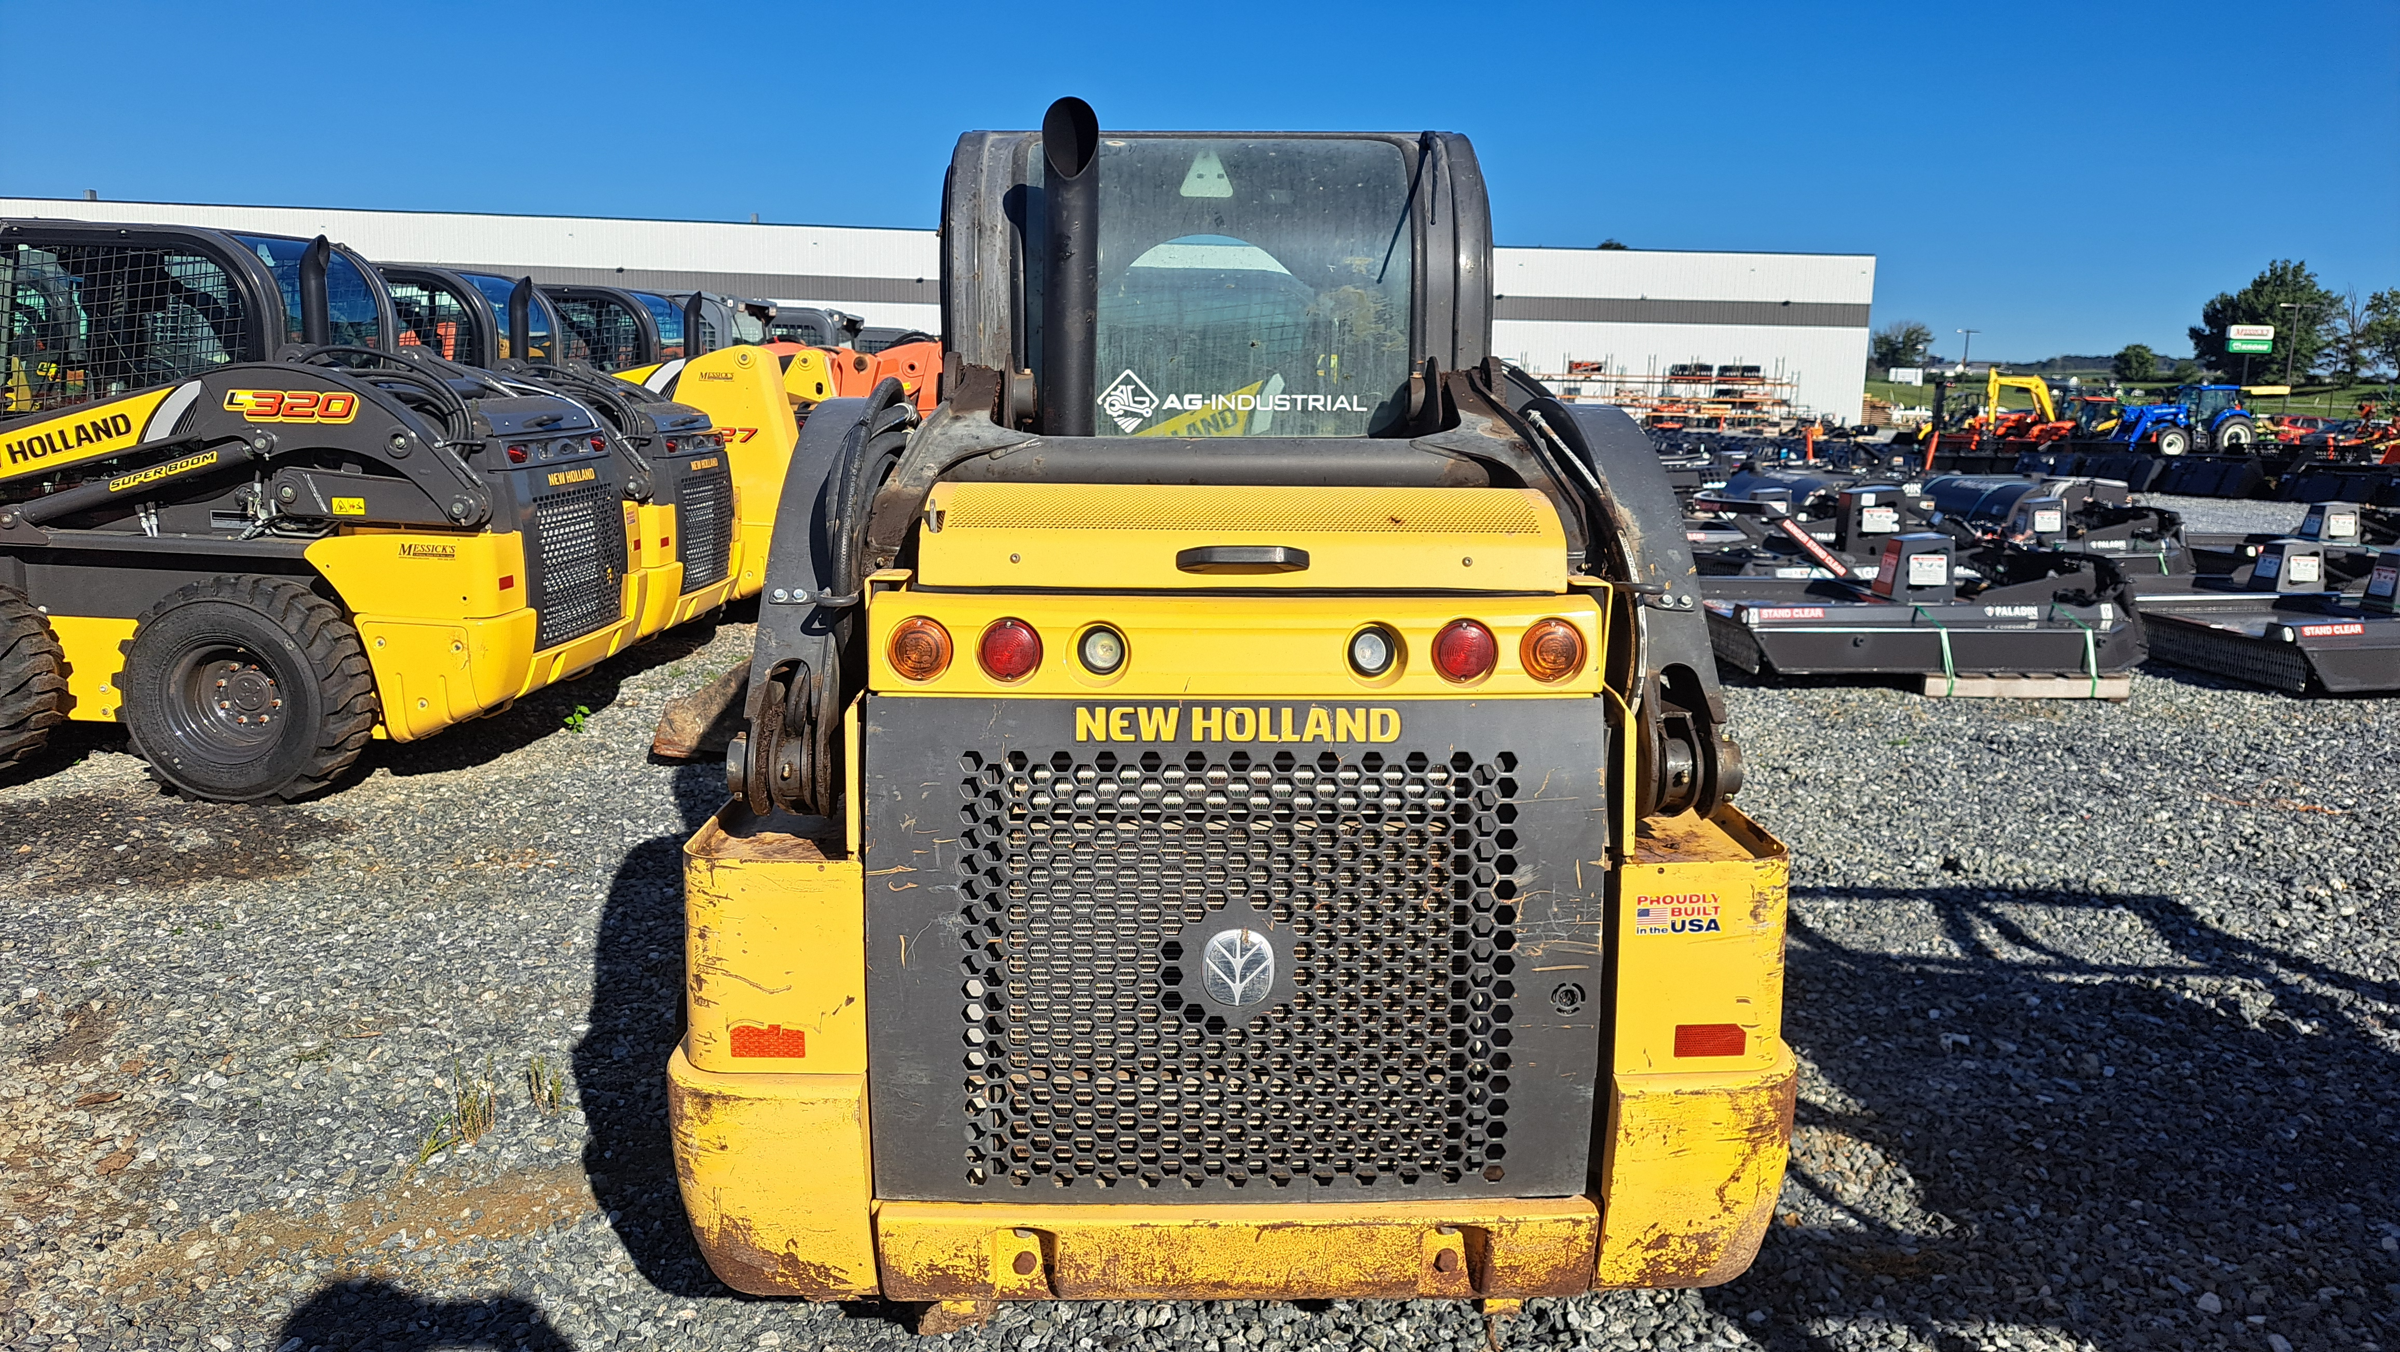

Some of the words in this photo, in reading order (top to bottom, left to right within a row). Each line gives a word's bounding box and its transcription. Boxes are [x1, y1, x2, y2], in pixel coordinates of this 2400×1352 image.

[226, 391, 356, 418] L320
[1162, 393, 1367, 412] AG-INDUSTRIAL
[6, 413, 132, 464] HOLLAND
[110, 468, 164, 489] SUPER
[167, 452, 216, 474] BOOM
[547, 471, 566, 486] NEW
[565, 467, 596, 483] HOLLAND
[398, 543, 456, 556] MESSICK'S
[1761, 608, 1791, 619] STAND
[1793, 608, 1823, 618] CLEAR
[1995, 606, 2038, 618] PALADIN
[2303, 625, 2332, 636] STAND
[2334, 624, 2361, 635] CLEAR
[1076, 707, 1180, 742] NEW
[1191, 707, 1400, 743] HOLLAND
[1637, 893, 1720, 906] PROUDLY
[1671, 906, 1720, 917] BUILT
[1671, 918, 1720, 933] USA
